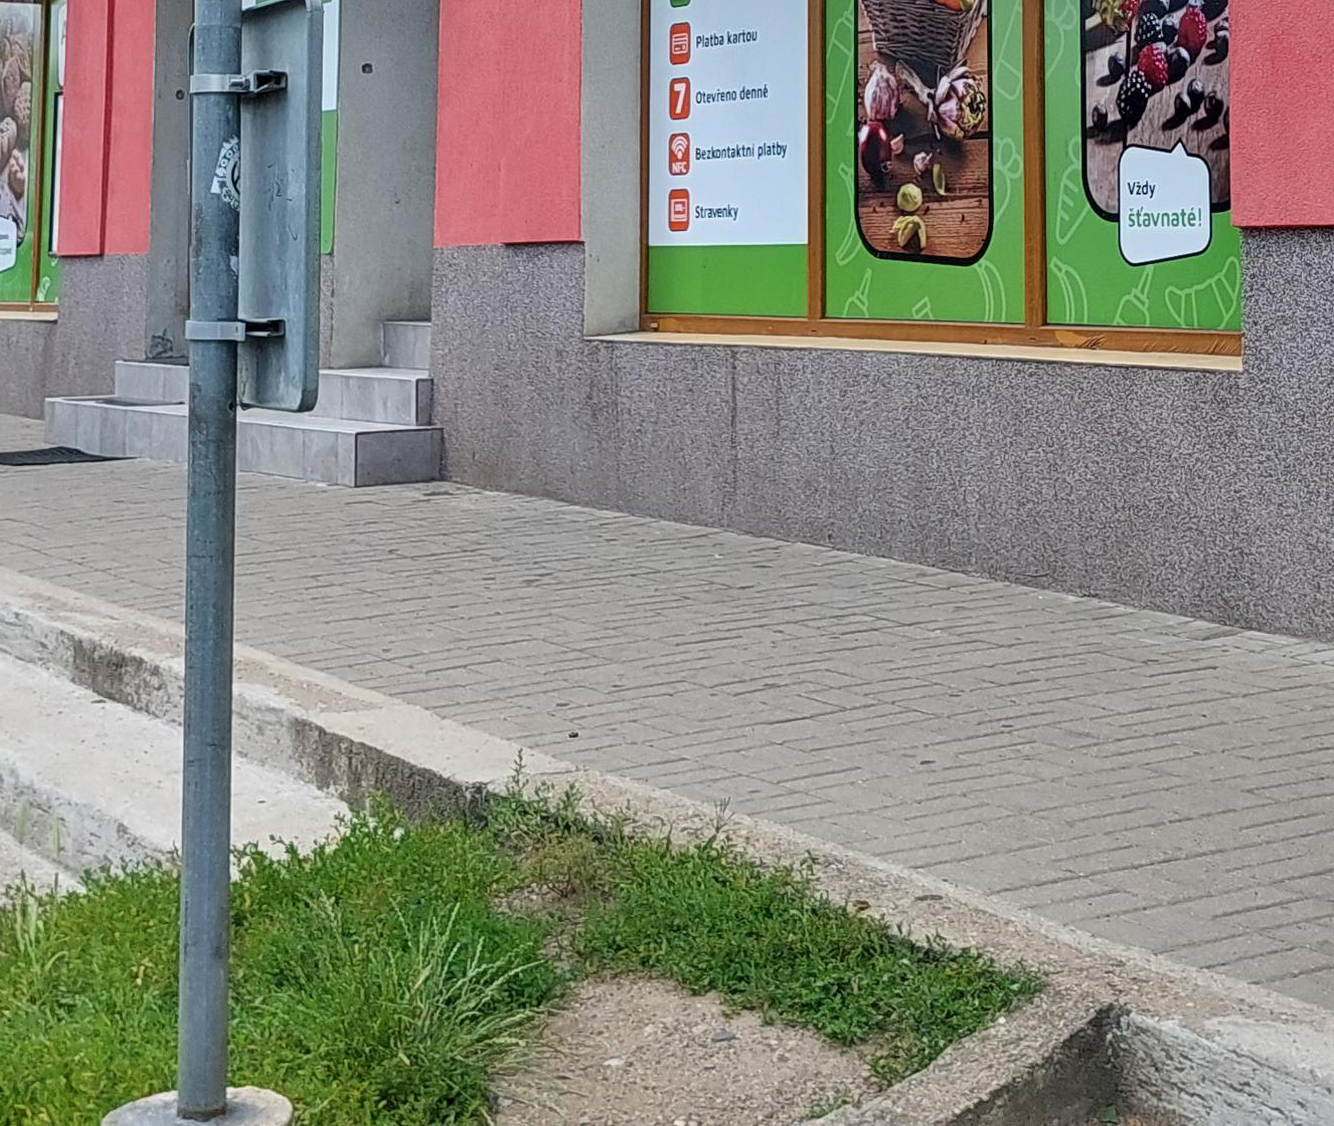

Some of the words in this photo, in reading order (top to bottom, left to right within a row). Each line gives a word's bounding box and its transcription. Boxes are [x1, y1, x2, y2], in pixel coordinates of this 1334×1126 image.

[696, 33, 725, 49] Platba
[727, 30, 758, 45] kartou
[674, 82, 687, 115] 7
[695, 89, 738, 104] Otevřeno
[739, 85, 769, 101] denně
[695, 144, 755, 161] Bezkontaktní
[757, 141, 788, 160] platby
[672, 161, 688, 174] NFC
[1127, 180, 1156, 199] Vždy
[695, 205, 740, 221] Stravenky
[1128, 206, 1203, 228] šťavnaté!
